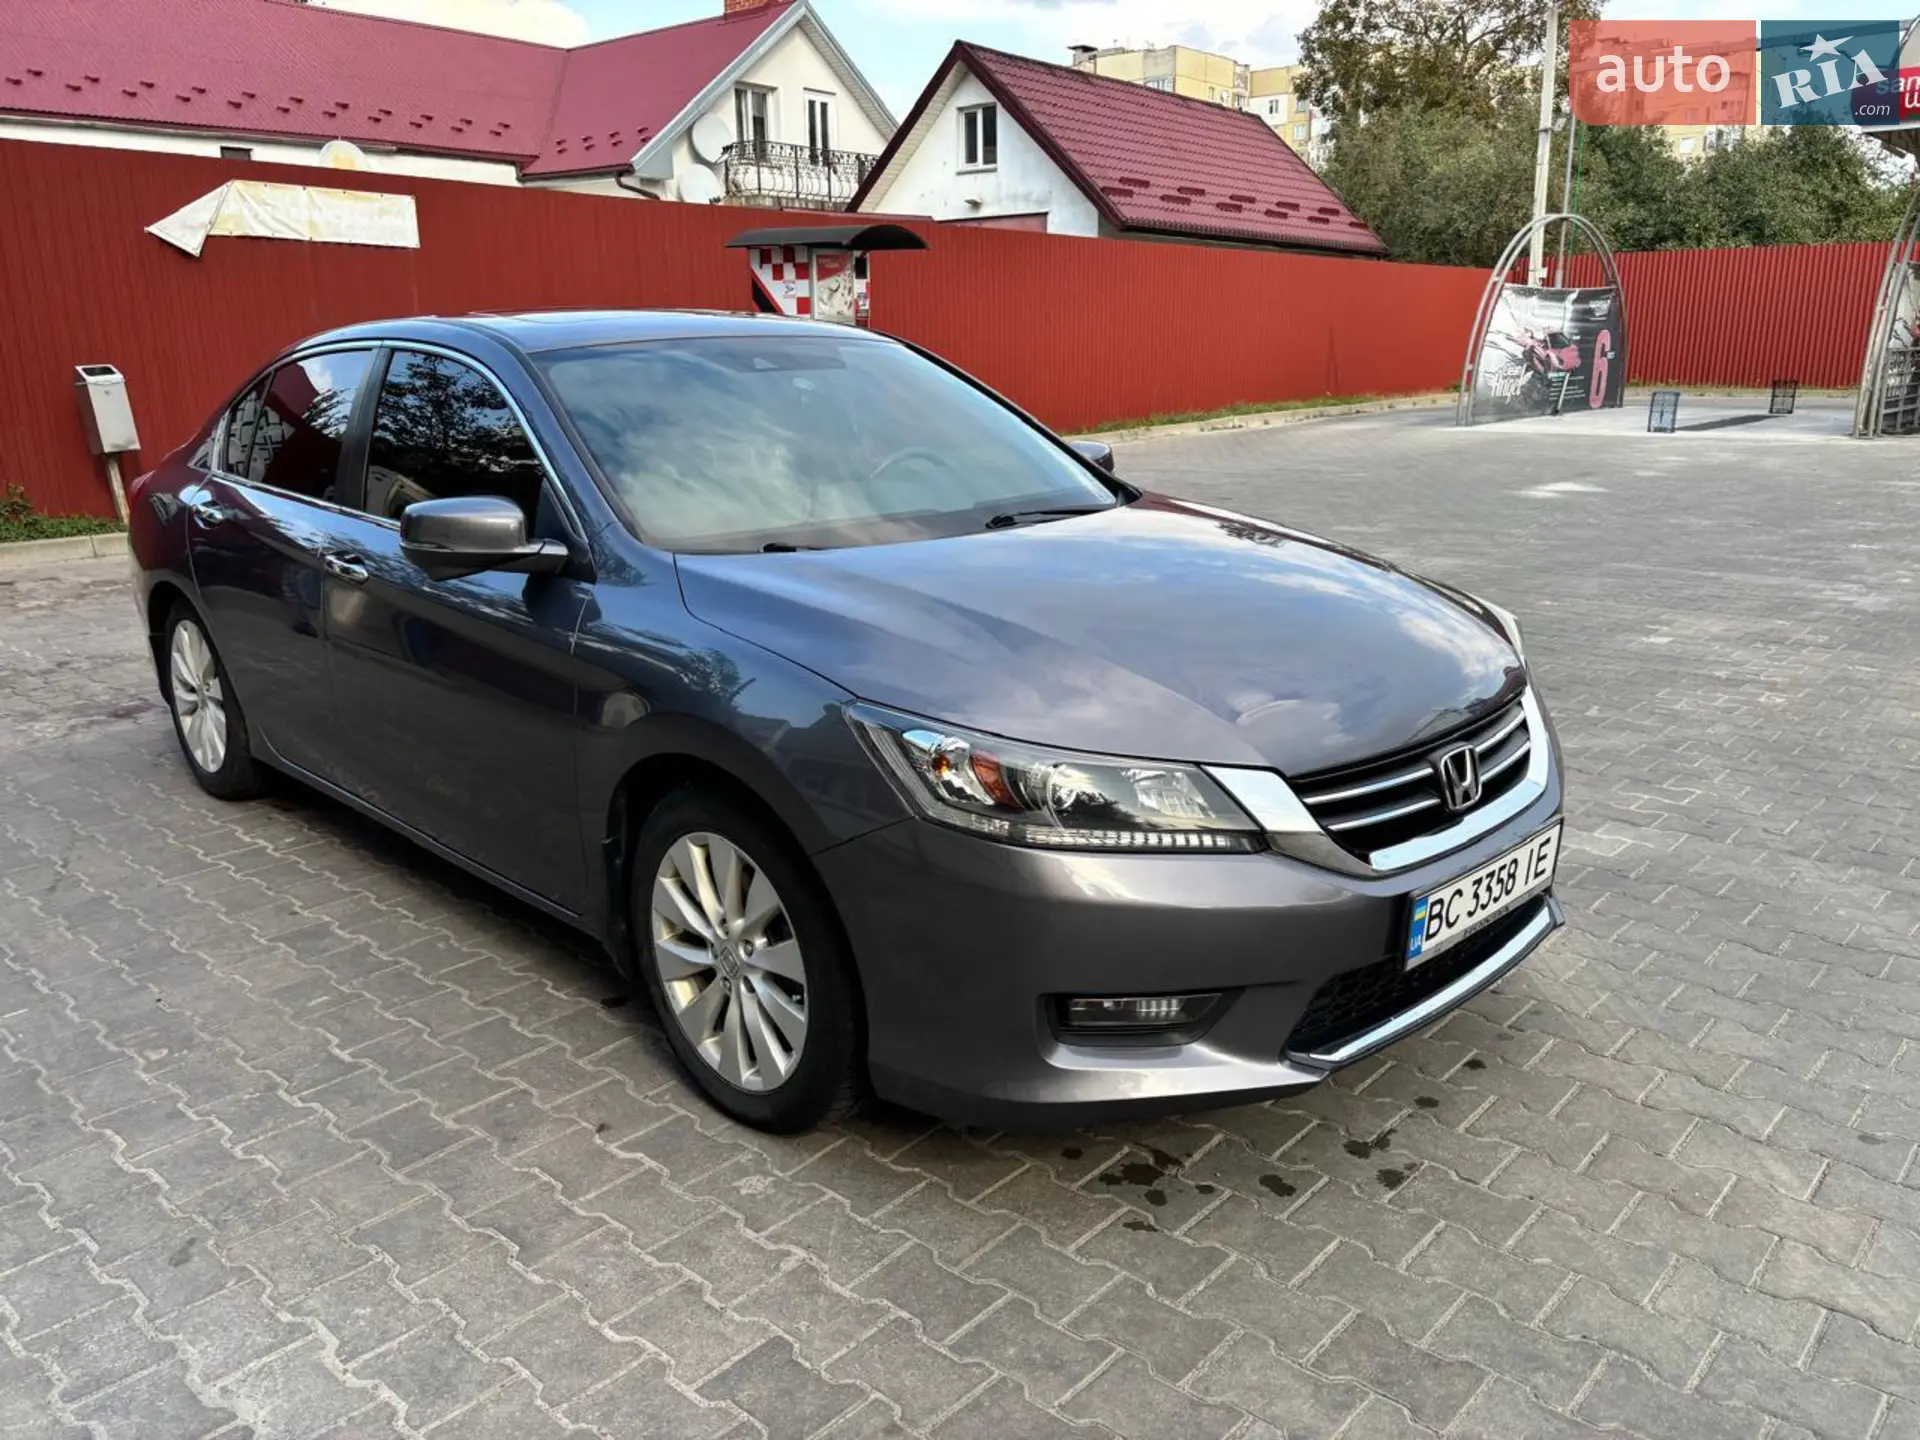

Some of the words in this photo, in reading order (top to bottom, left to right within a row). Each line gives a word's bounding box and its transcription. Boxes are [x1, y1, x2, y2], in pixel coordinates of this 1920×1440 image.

[1589, 329, 1611, 409] 6
[1424, 889, 1463, 942] BC
[1467, 858, 1518, 918] 3358
[1524, 837, 1552, 887] IE
